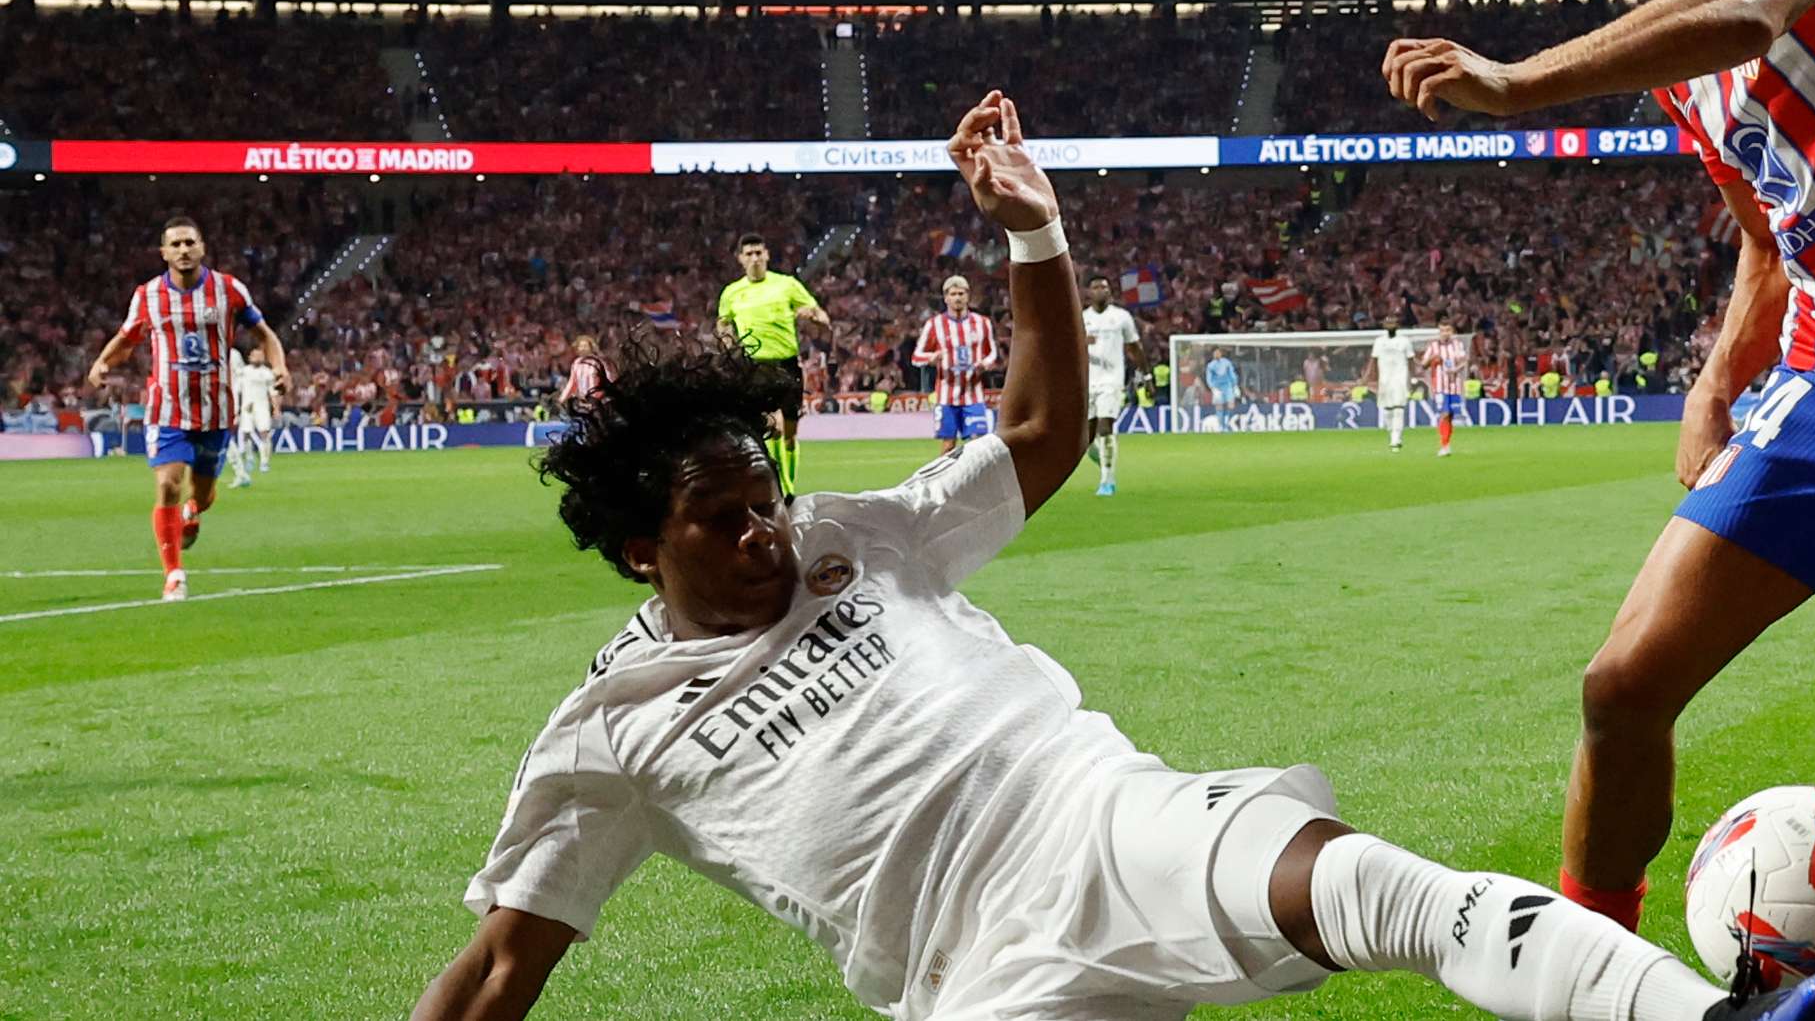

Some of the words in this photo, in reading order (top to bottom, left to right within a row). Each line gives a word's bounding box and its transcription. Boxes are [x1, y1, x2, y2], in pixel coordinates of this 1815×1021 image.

[244, 143, 354, 169] ATLÉTICO
[379, 149, 474, 170] MADRID
[1259, 134, 1375, 162] ATLÉTICO
[1378, 137, 1412, 159] DE
[1416, 134, 1516, 158] MADRID
[1561, 132, 1579, 153] 0
[1599, 130, 1667, 152] 87:19
[1562, 393, 1637, 425] AIR
[381, 423, 448, 451] AIR
[689, 593, 885, 760] Emirates
[755, 704, 806, 761] FLY
[805, 632, 896, 719] BETTER
